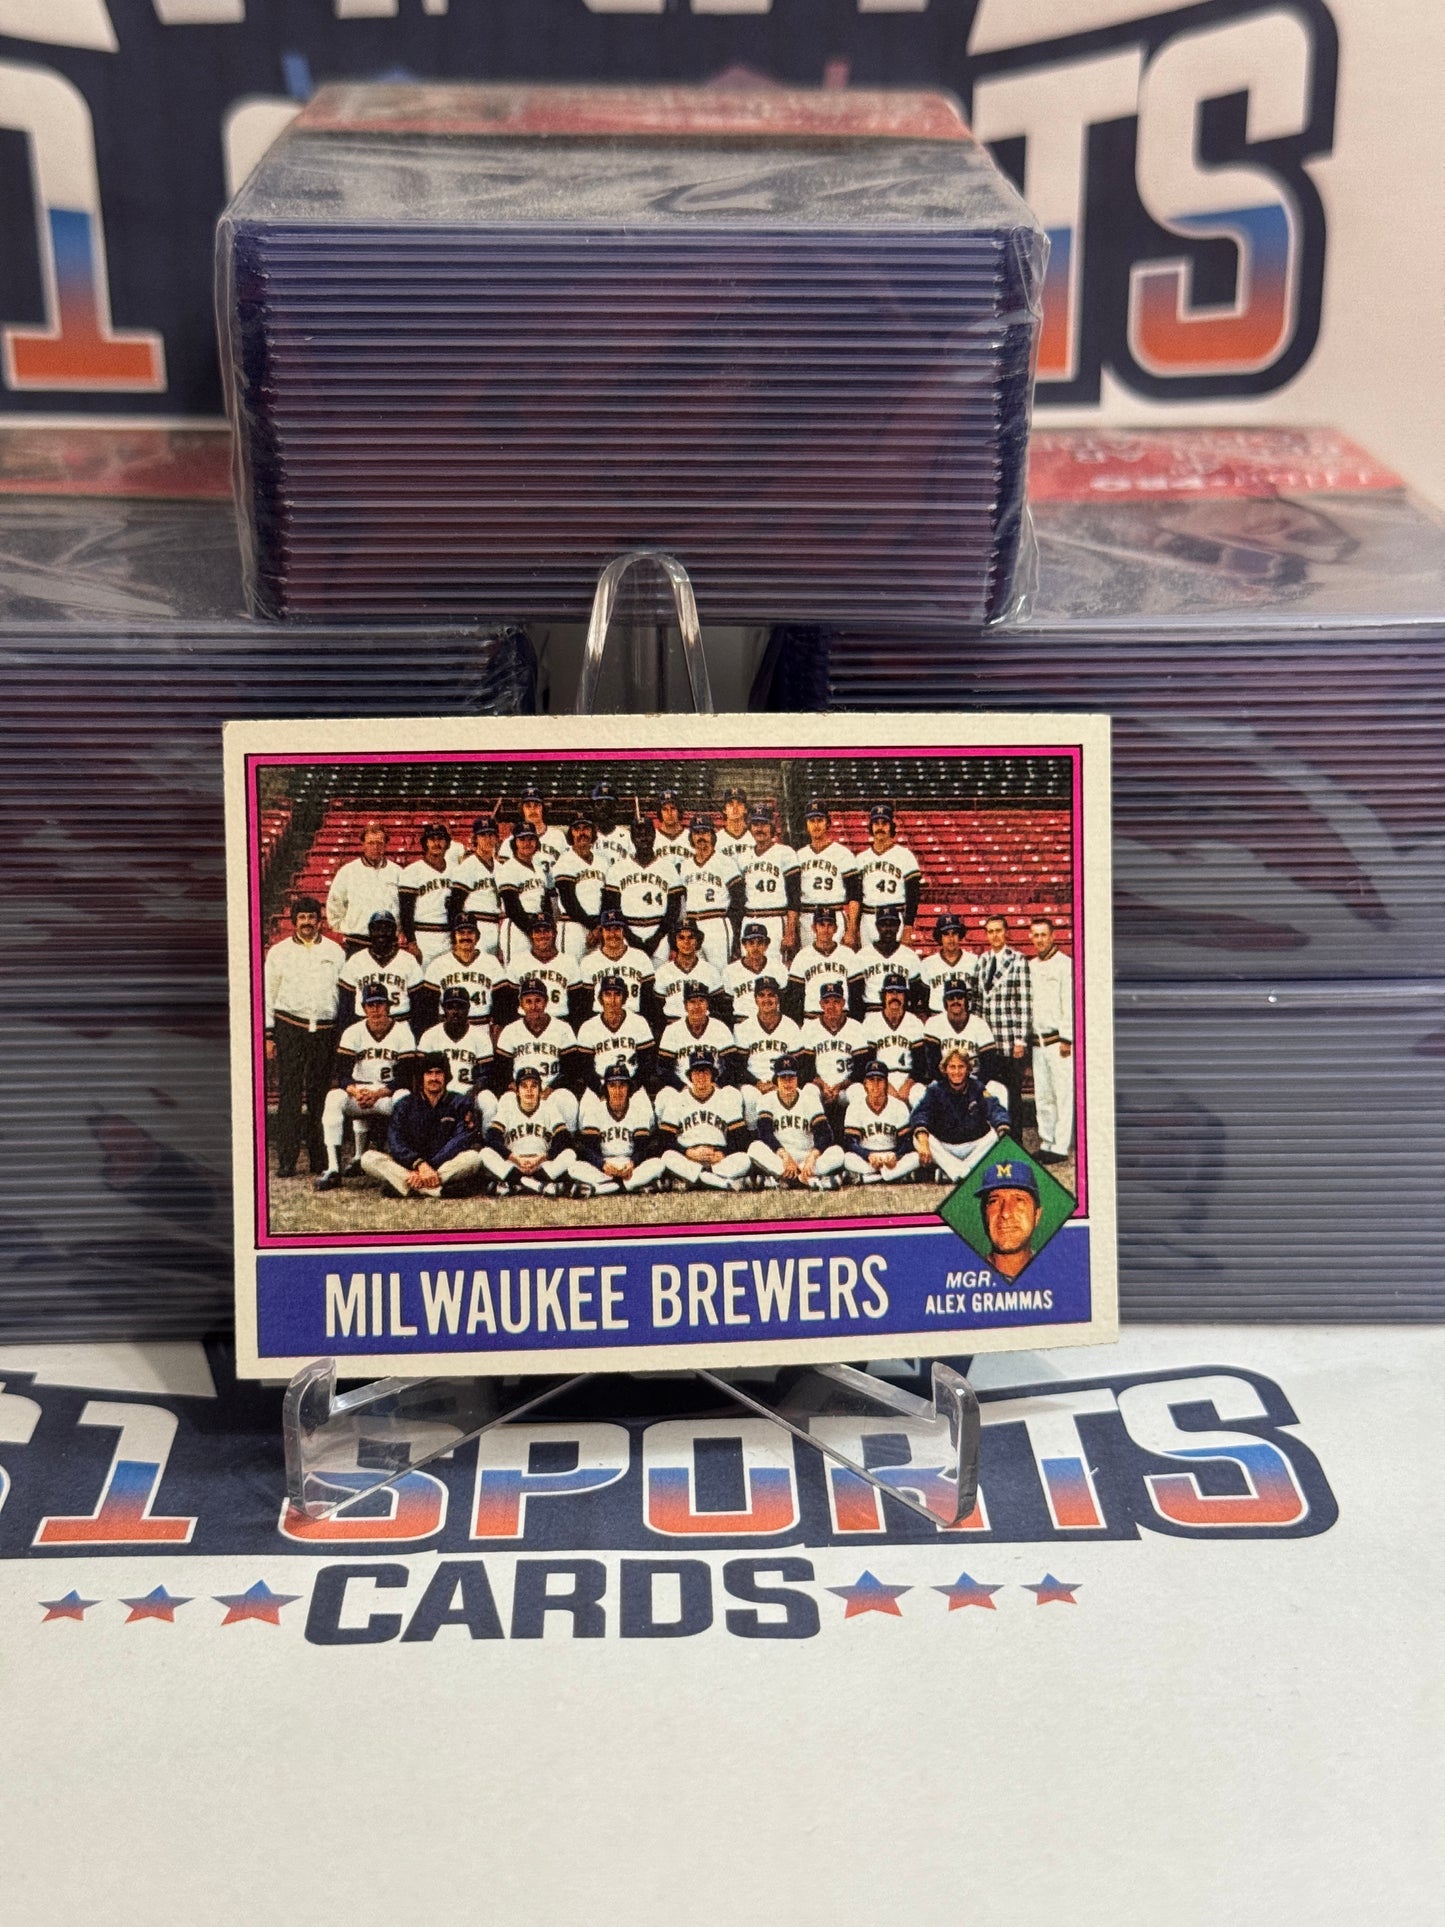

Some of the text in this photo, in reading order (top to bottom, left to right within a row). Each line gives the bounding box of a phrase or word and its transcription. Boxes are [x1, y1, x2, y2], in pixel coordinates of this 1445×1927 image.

[755, 879, 776, 892] 40
[813, 877, 833, 891] 29
[876, 879, 897, 894] 43
[642, 891, 663, 906] 44
[705, 889, 715, 902] 2
[996, 1164, 1011, 1178] M
[946, 1271, 997, 1288] MGR.
[325, 1254, 889, 1338] MILWAUKEE BREWERS
[925, 1290, 1053, 1315] ALEX GRAMMAS
[277, 1375, 1309, 1541] SPORTS
[304, 1557, 821, 1645] CARDS
